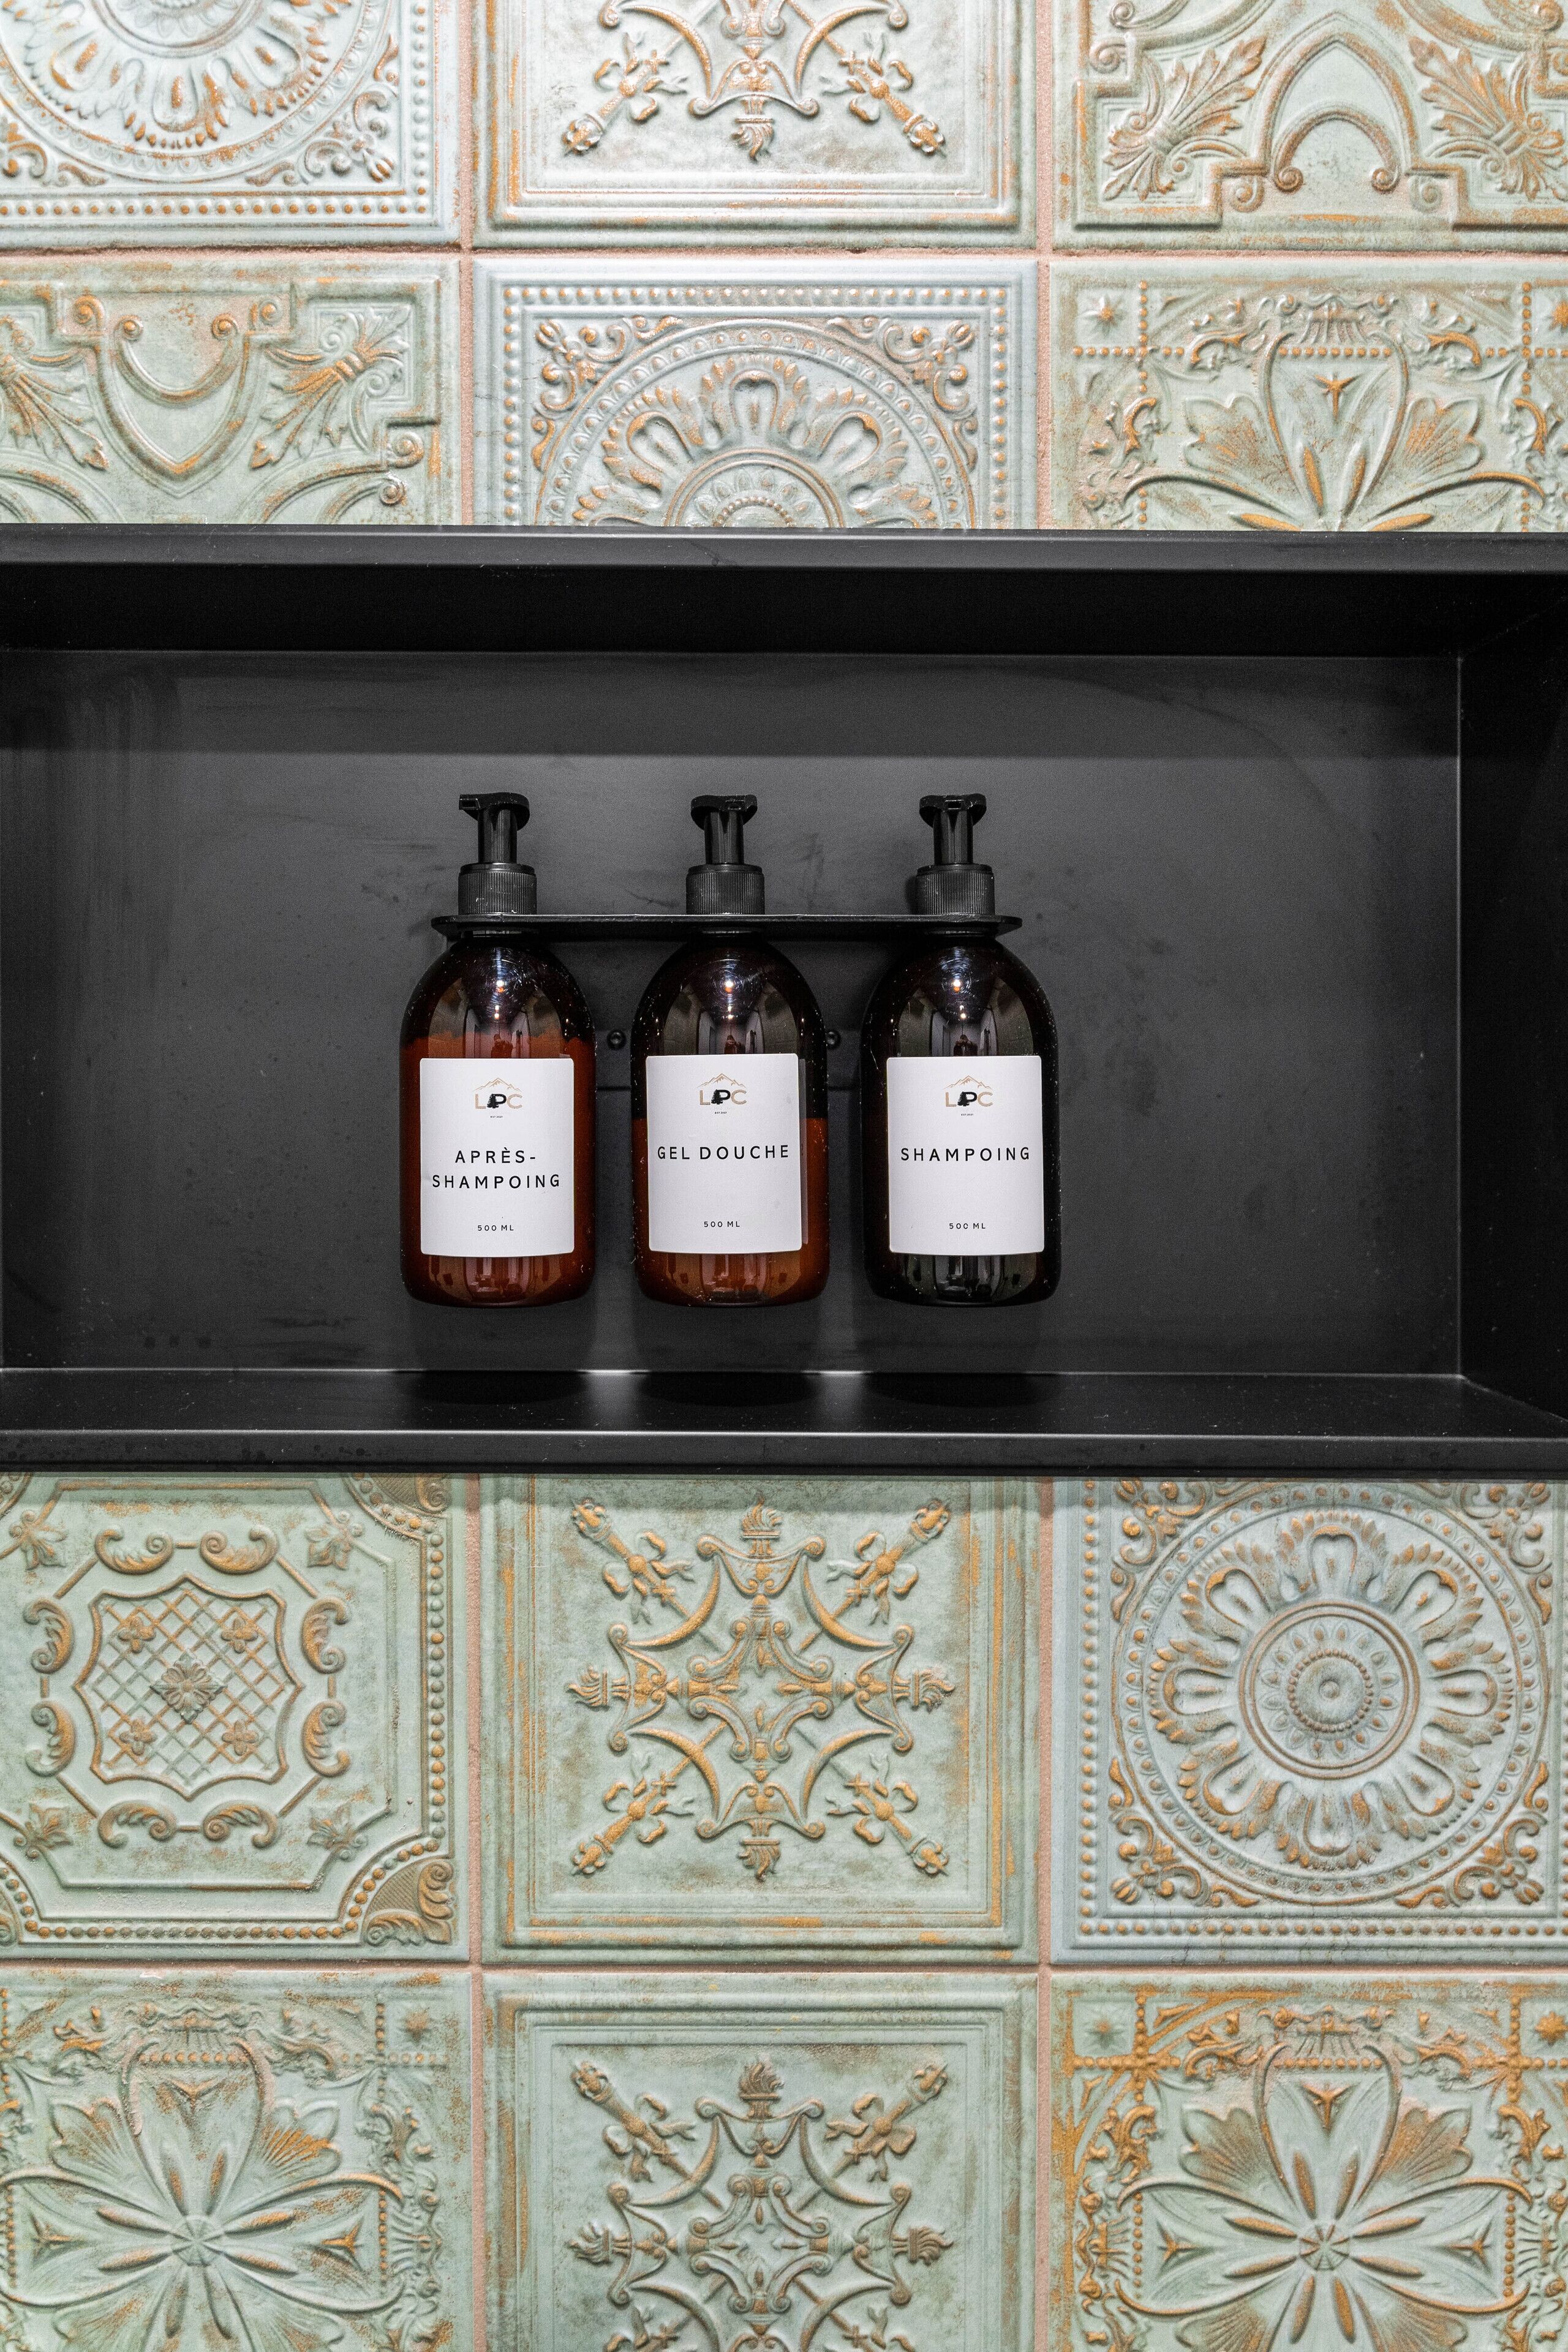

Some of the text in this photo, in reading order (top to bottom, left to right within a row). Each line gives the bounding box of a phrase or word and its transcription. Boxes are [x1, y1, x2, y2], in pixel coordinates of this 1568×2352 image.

[455, 1147, 536, 1164] APRÈS-
[657, 1146, 690, 1160] GEL
[699, 1145, 788, 1160] DOUCHE
[902, 1147, 1029, 1162] SHAMPOING
[432, 1174, 559, 1189] SHAMPOING
